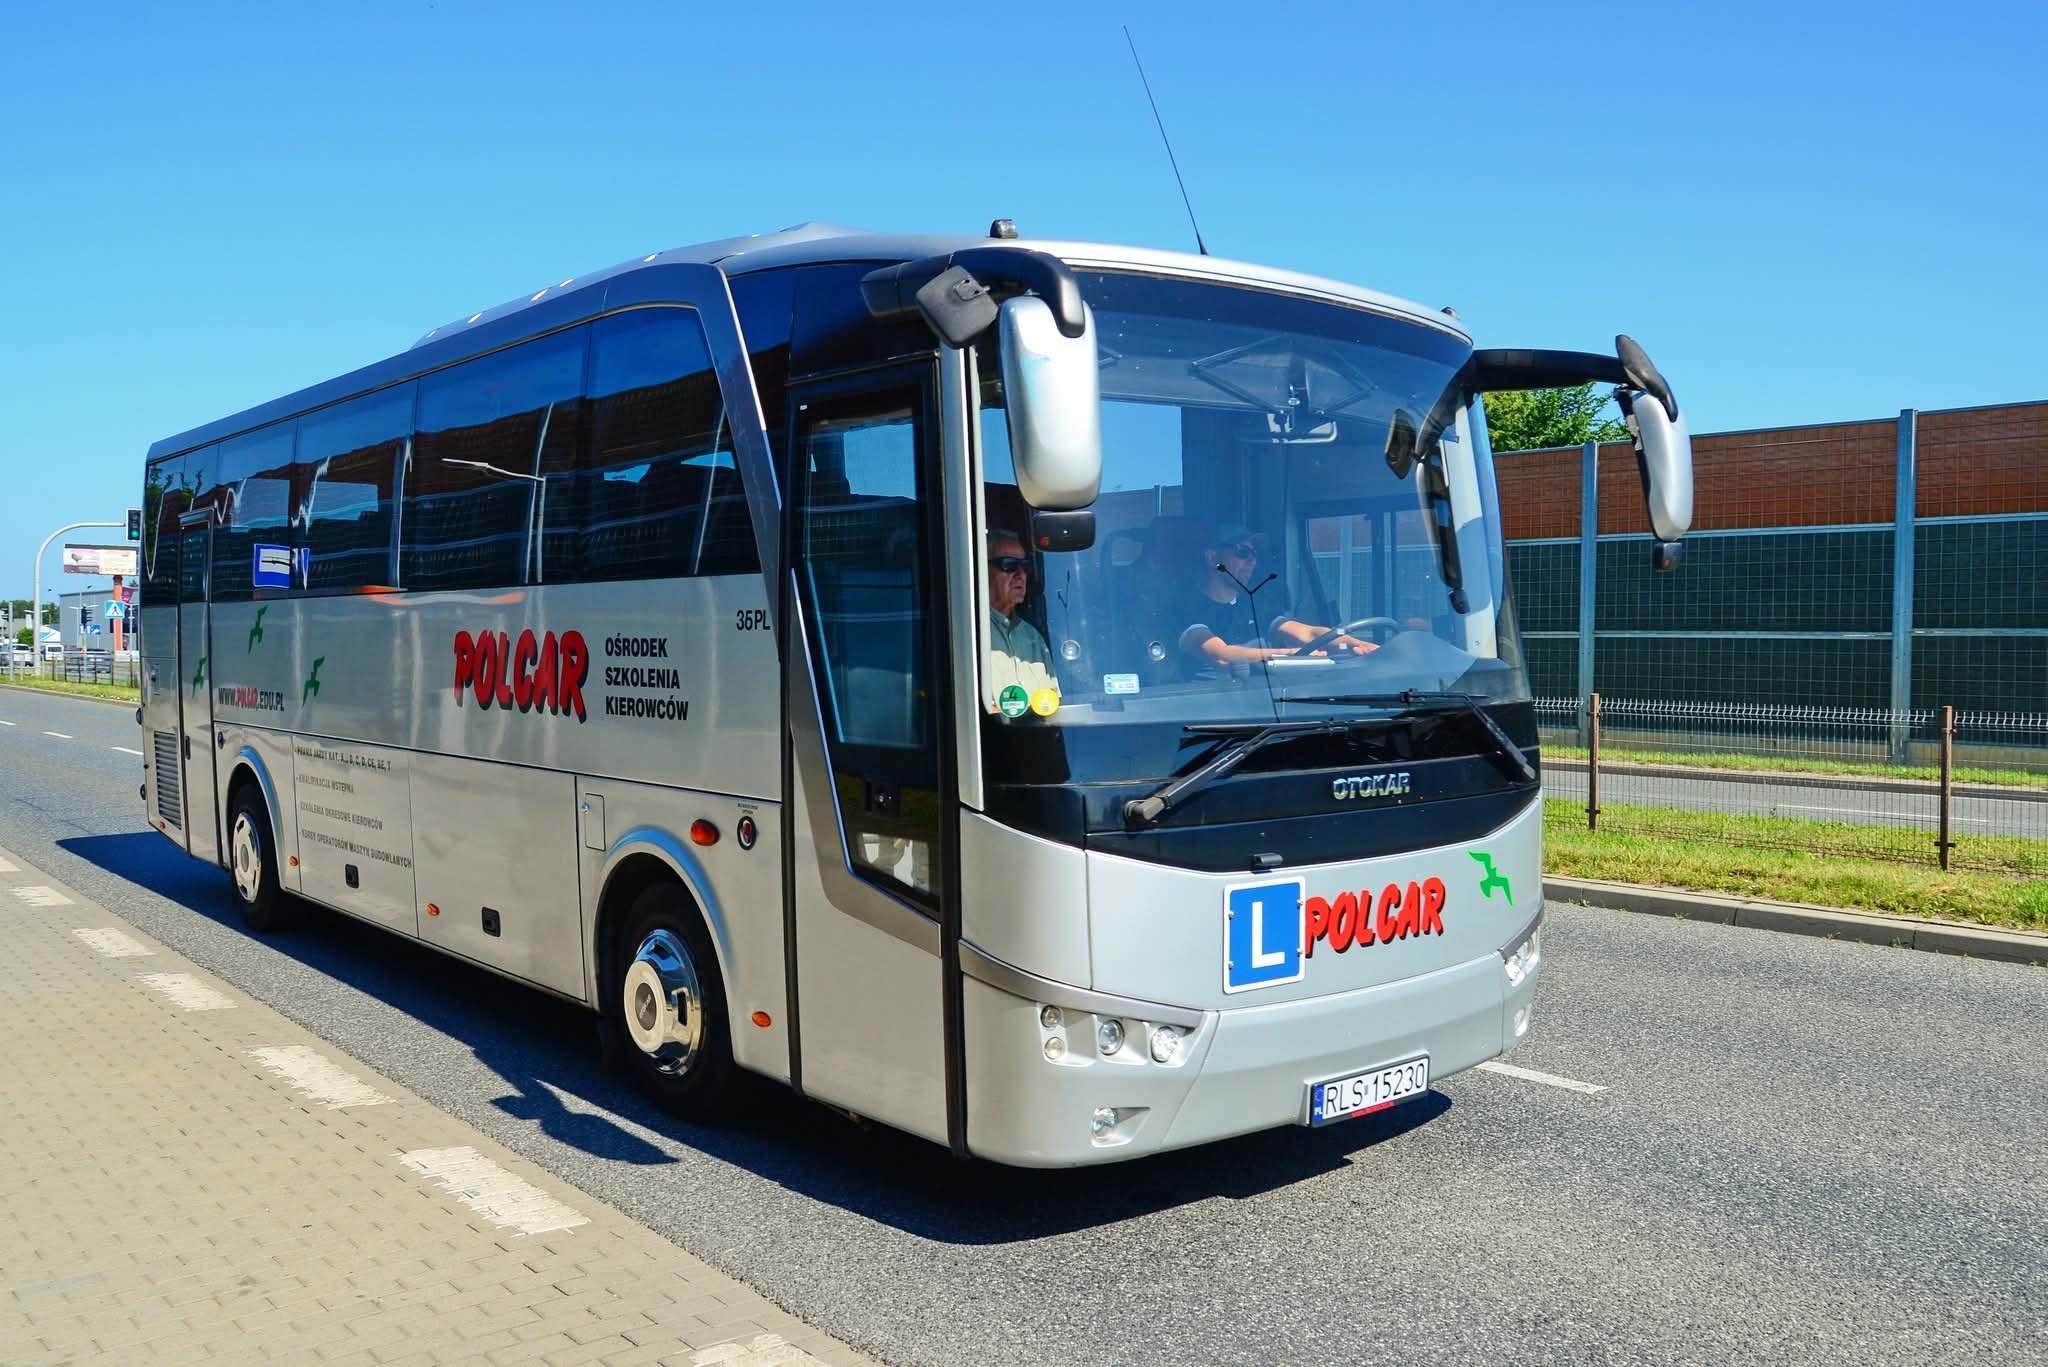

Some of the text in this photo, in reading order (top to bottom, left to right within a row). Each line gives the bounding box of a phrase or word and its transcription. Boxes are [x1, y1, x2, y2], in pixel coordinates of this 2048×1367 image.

[605, 633, 669, 658] OŚRODEK
[453, 629, 589, 724] POLCAR
[605, 667, 681, 690] SZKOLENIA
[605, 695, 689, 721] KIEROWCÓW
[1333, 772, 1411, 800] OTOKAR
[1251, 901, 1285, 968] L
[1305, 877, 1446, 958] POLCAR
[1325, 1063, 1426, 1117] RLS 15230
